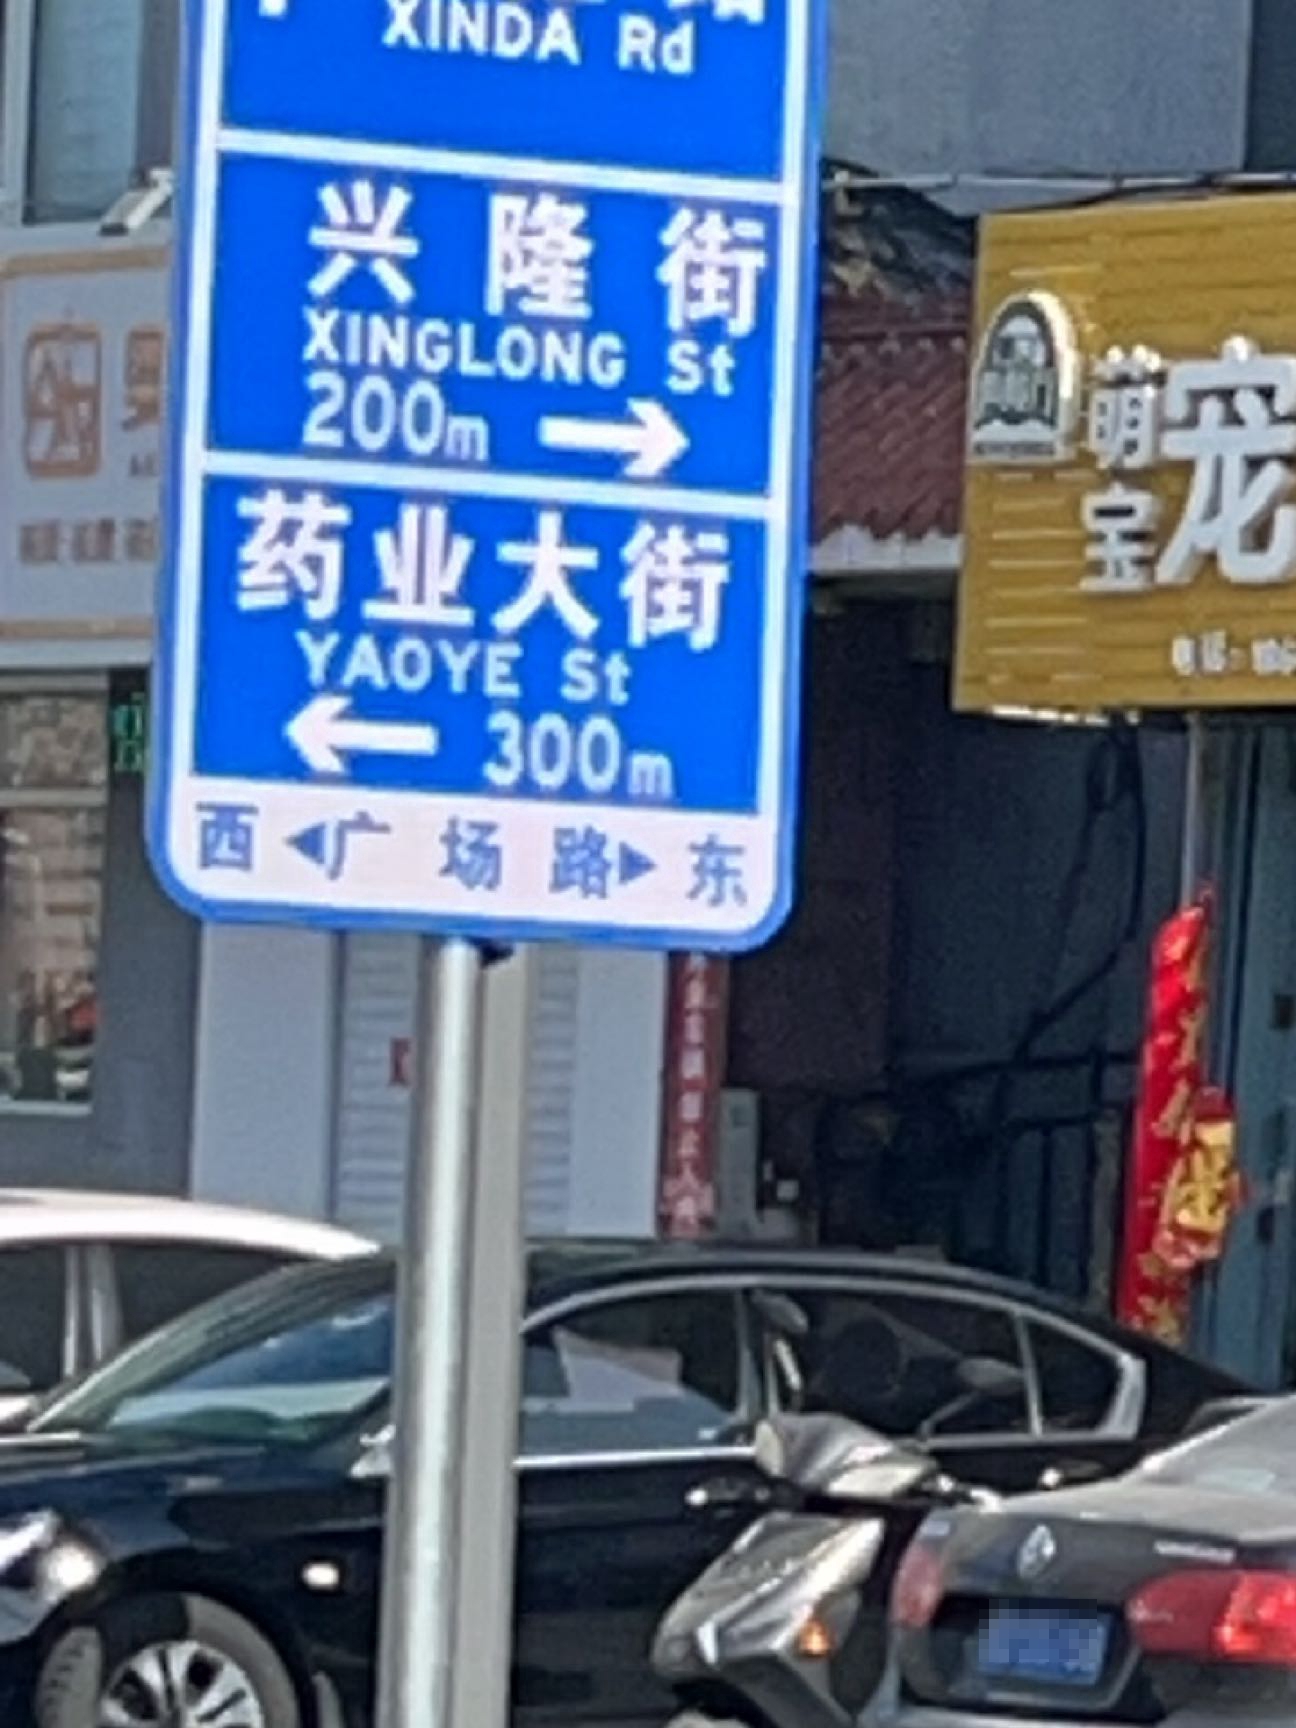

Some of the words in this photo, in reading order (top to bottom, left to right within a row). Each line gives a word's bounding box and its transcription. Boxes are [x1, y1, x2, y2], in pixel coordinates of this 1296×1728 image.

[382, 0, 580, 66] XINDA
[617, 16, 695, 75] Rd
[306, 179, 767, 340] 兴隆街
[302, 308, 626, 390] XINGLONG
[667, 344, 736, 396] St
[302, 373, 489, 462] 200m
[1080, 345, 1160, 592] 萌宝
[236, 487, 731, 652] 药业大街
[295, 631, 521, 698] YAOYE
[560, 649, 632, 706] St
[482, 711, 675, 800] 300m
[195, 804, 259, 871] 西
[324, 811, 612, 897] 广场路
[686, 835, 748, 906] 东
